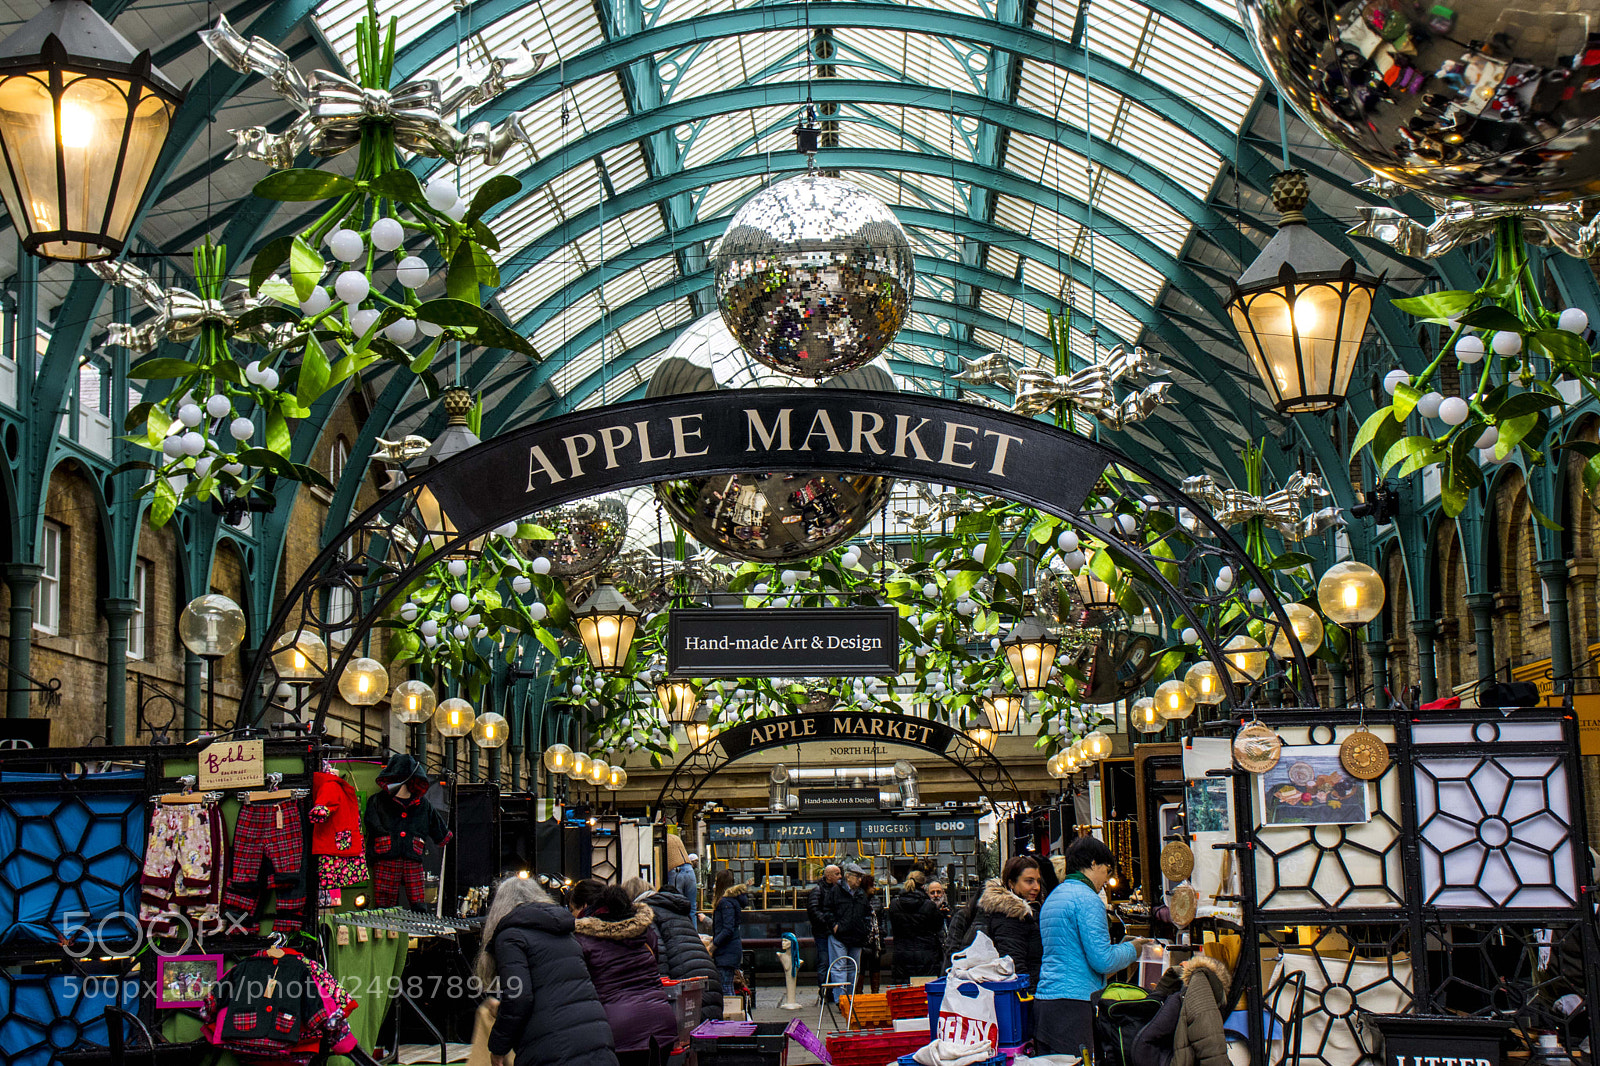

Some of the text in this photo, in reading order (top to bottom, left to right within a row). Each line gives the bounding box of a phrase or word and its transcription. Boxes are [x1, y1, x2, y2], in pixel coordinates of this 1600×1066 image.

[525, 408, 1024, 493] APPLE MARKET
[684, 634, 883, 651] Hand-made Art & Design
[750, 717, 934, 746] APPLE MARKET
[830, 746, 888, 755] NORTH HALL
[724, 826, 754, 835] BOHO
[781, 826, 812, 835] PIZZA
[868, 824, 909, 833] BURGERS
[935, 821, 965, 831] BOHO
[937, 1016, 992, 1045] RELAY
